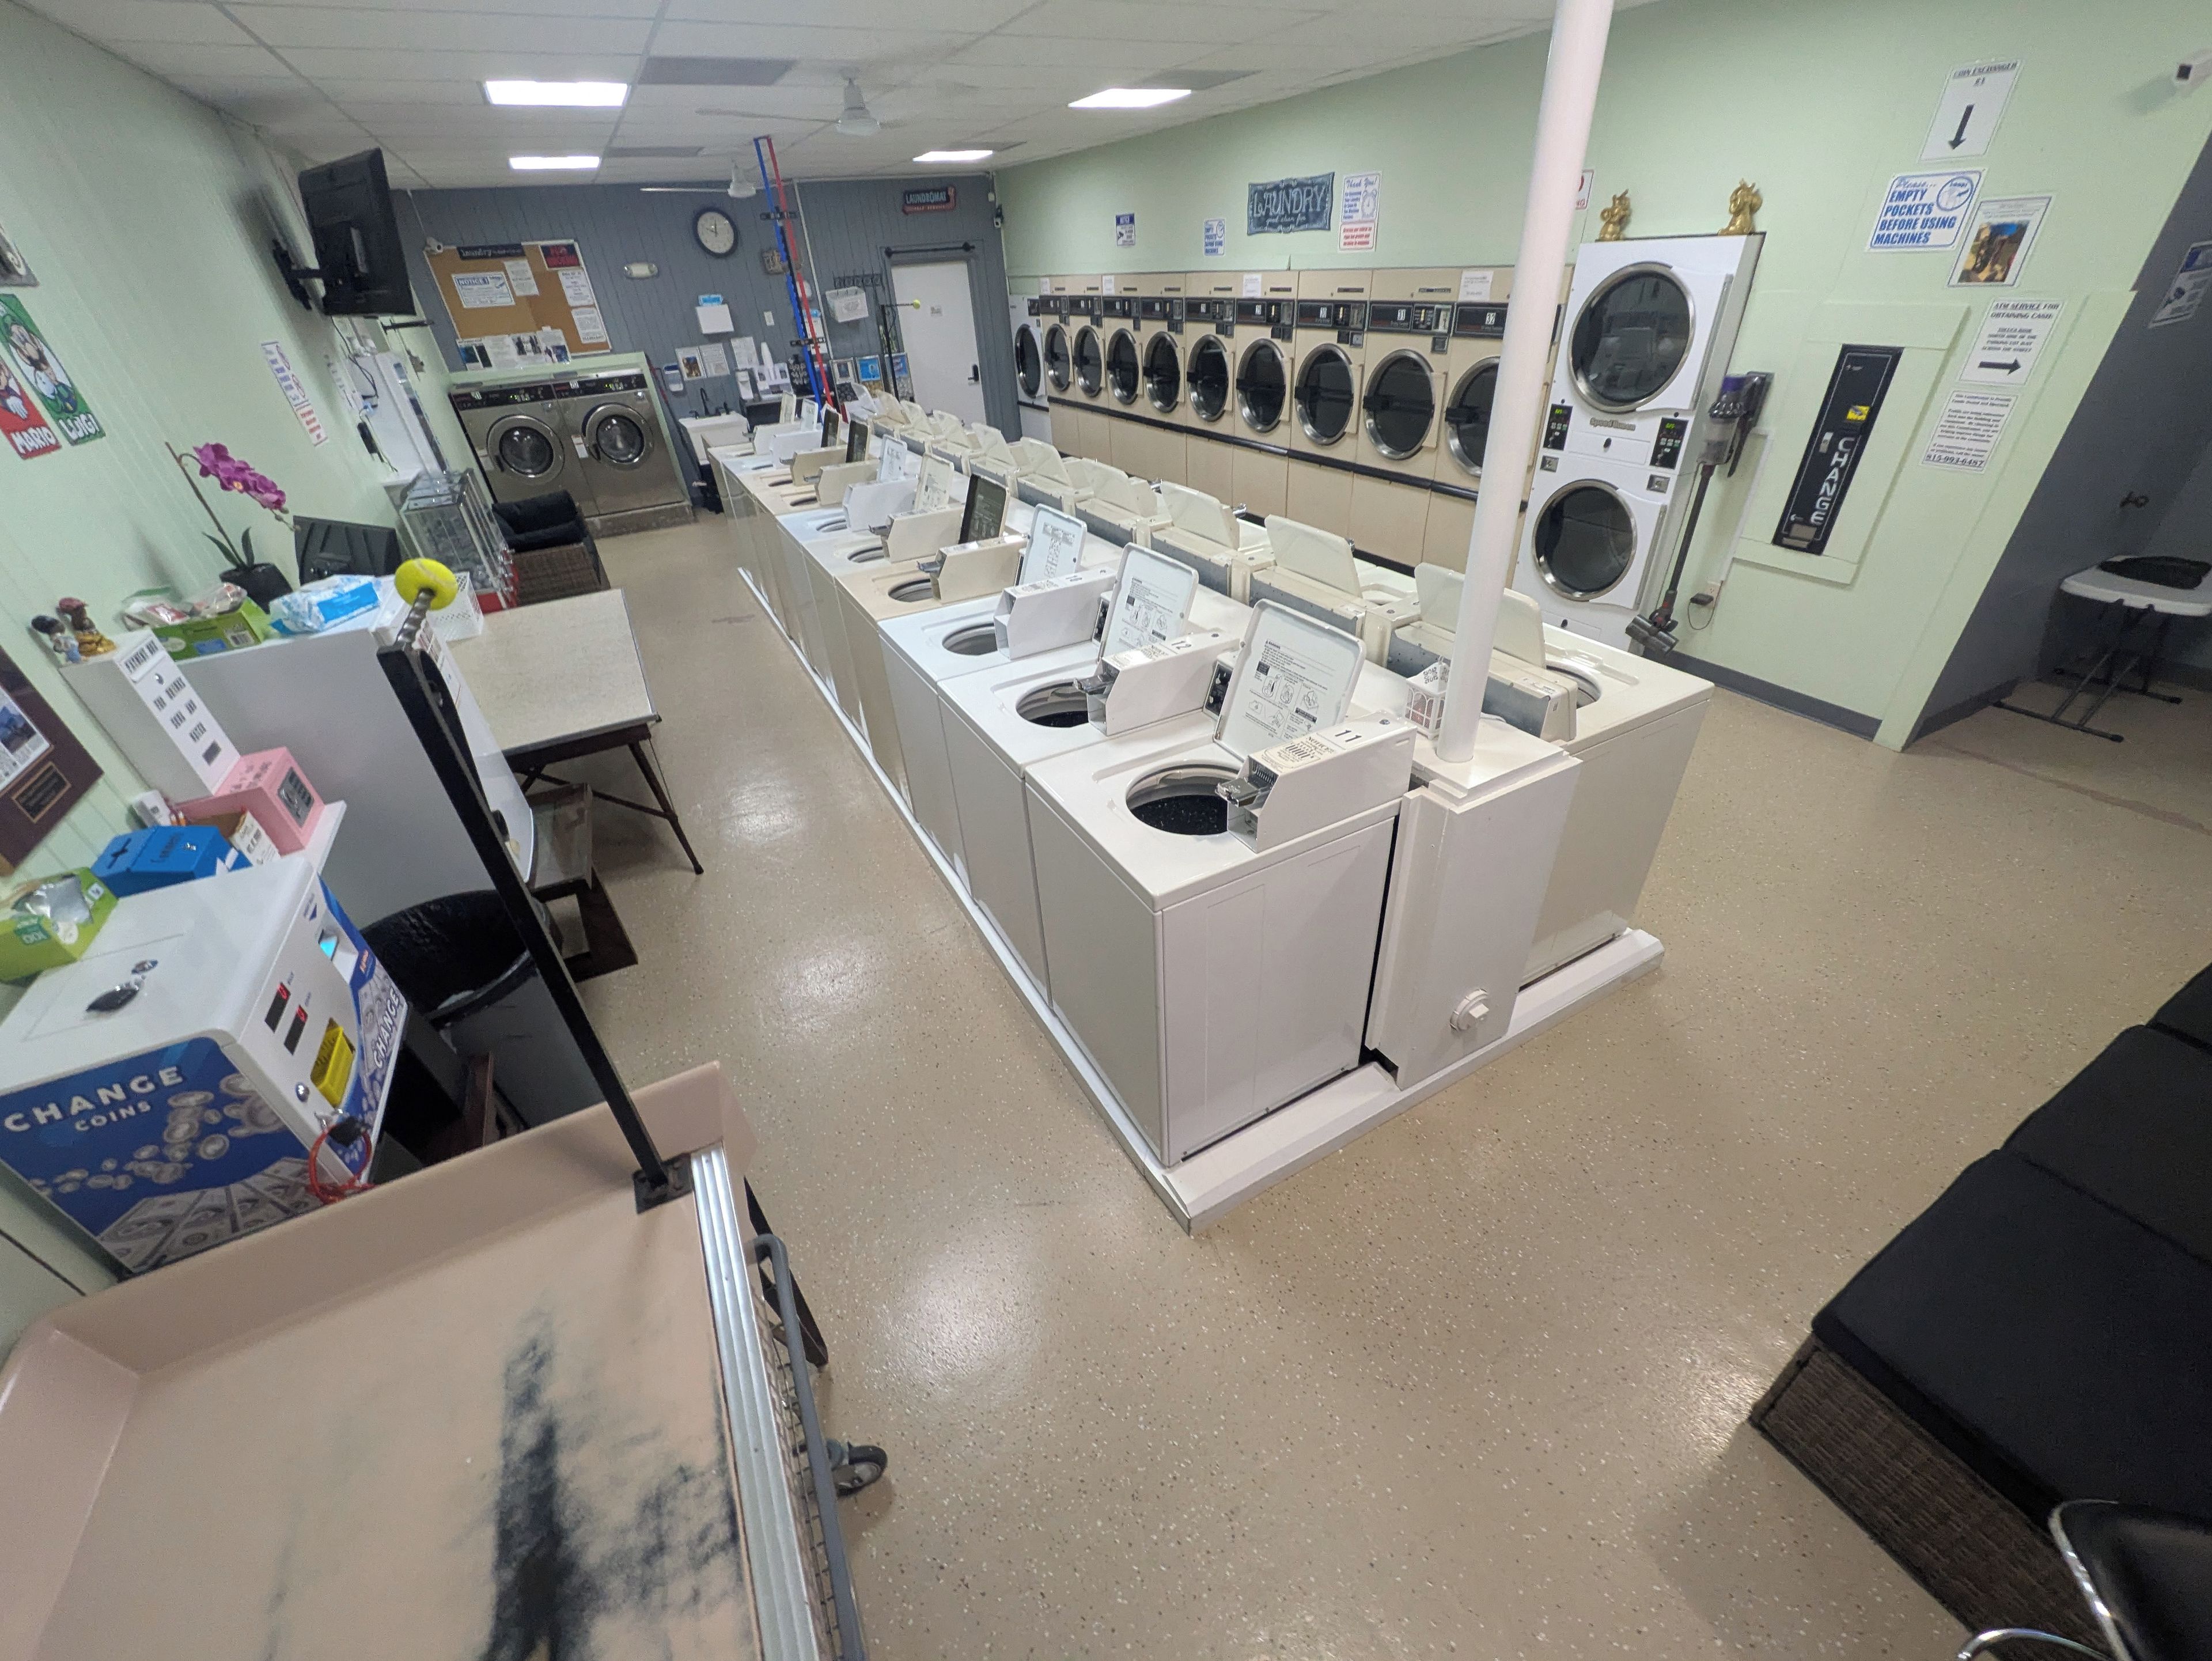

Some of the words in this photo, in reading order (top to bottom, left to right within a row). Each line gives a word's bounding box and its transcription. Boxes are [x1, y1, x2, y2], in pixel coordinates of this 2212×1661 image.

[906, 191, 946, 204] LAUNDROMAT
[1253, 185, 1325, 217] LAUNDRY
[1889, 188, 1927, 202] EMPTY
[1880, 218, 1919, 231] BEFORE
[1920, 216, 1957, 229] USING
[1884, 203, 1934, 217] POCKETS
[1874, 232, 1931, 244] MACHINES
[10, 426, 56, 454] MARIO
[58, 413, 100, 441] LUIGI
[1810, 437, 1855, 525] CHANGE
[1335, 729, 1362, 743] 11
[373, 986, 400, 1070] CHANGE
[4, 1065, 184, 1133] CHANGE
[74, 1100, 151, 1132] COINS
